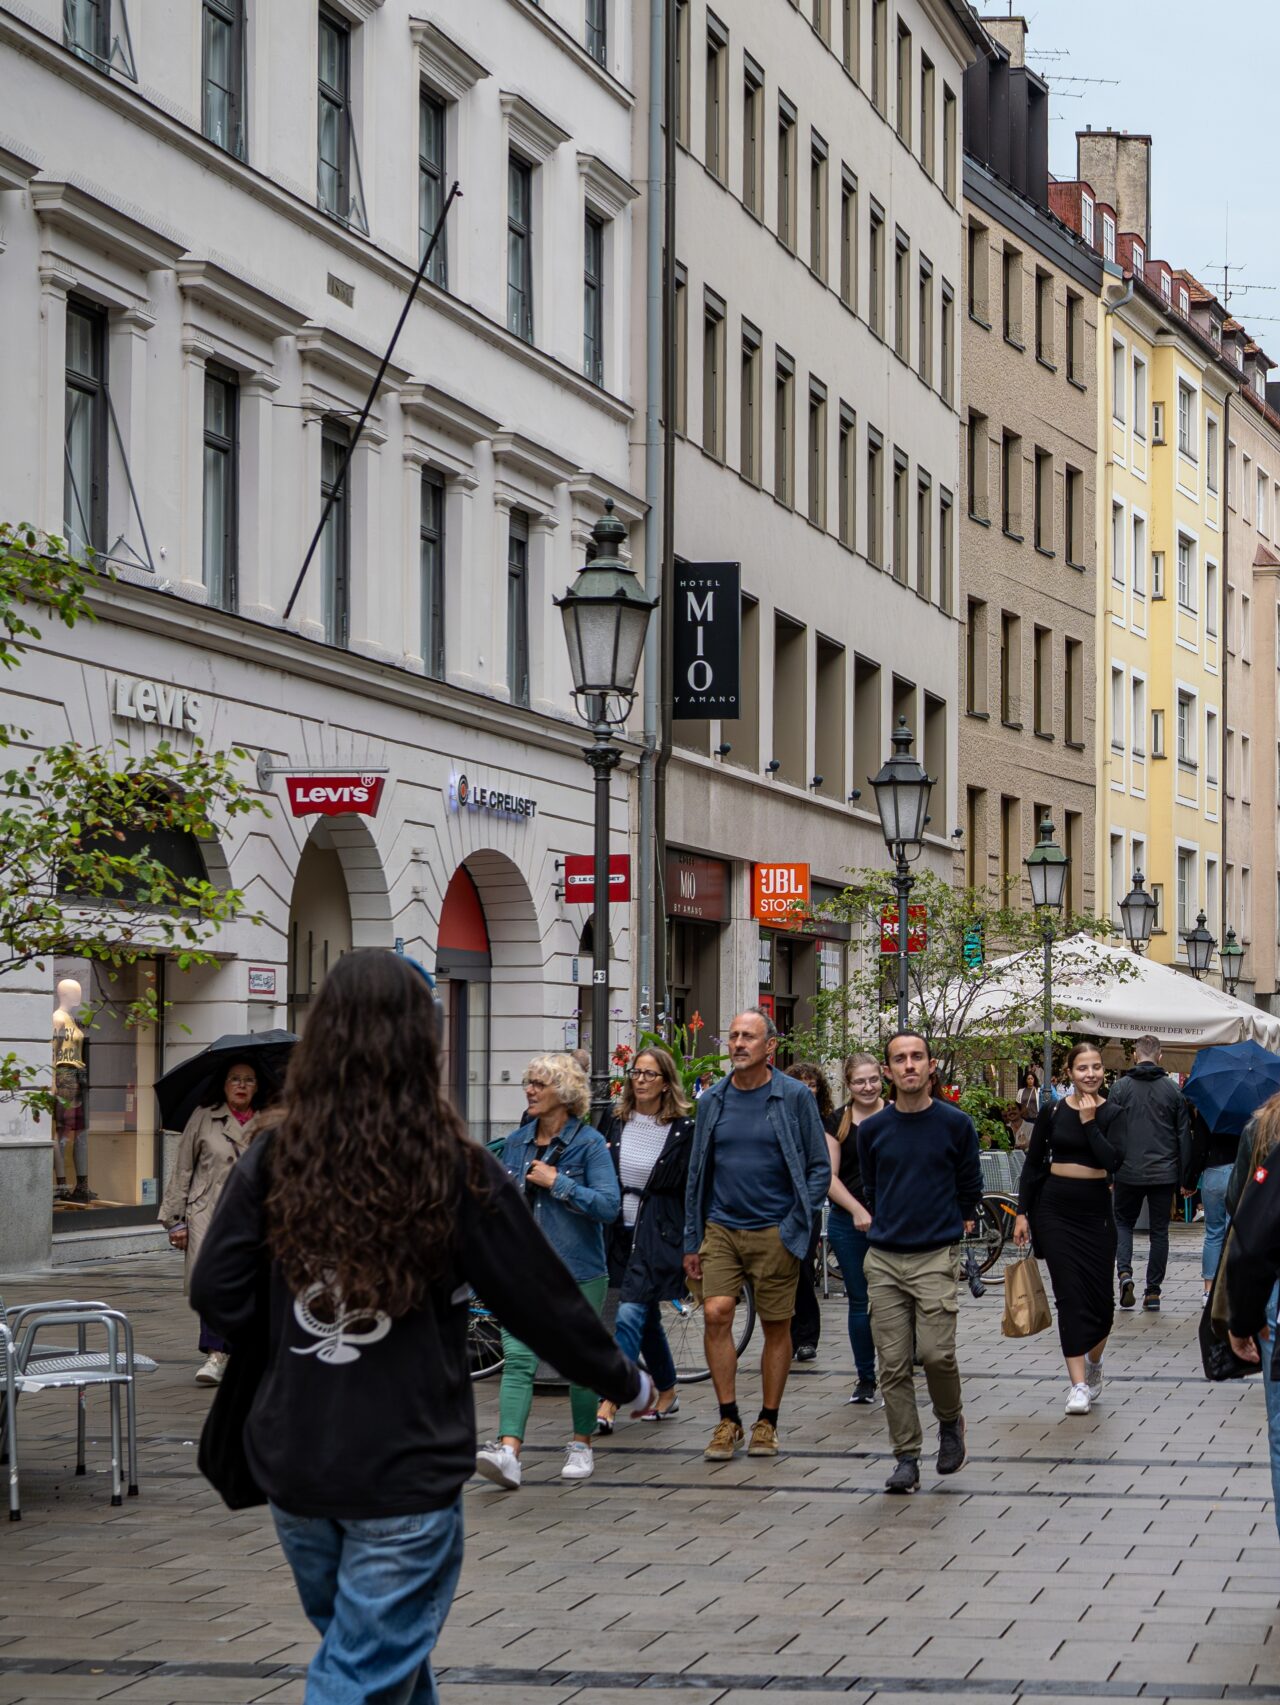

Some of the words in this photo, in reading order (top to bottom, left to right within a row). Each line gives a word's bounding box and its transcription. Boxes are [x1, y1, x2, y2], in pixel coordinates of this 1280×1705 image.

[473, 786, 487, 806] LE
[489, 791, 537, 817] CREUSET
[680, 870, 696, 900] MIO
[760, 868, 803, 894] JBL
[594, 972, 606, 982] 43
[1130, 1024, 1166, 1033] BRAUEREI
